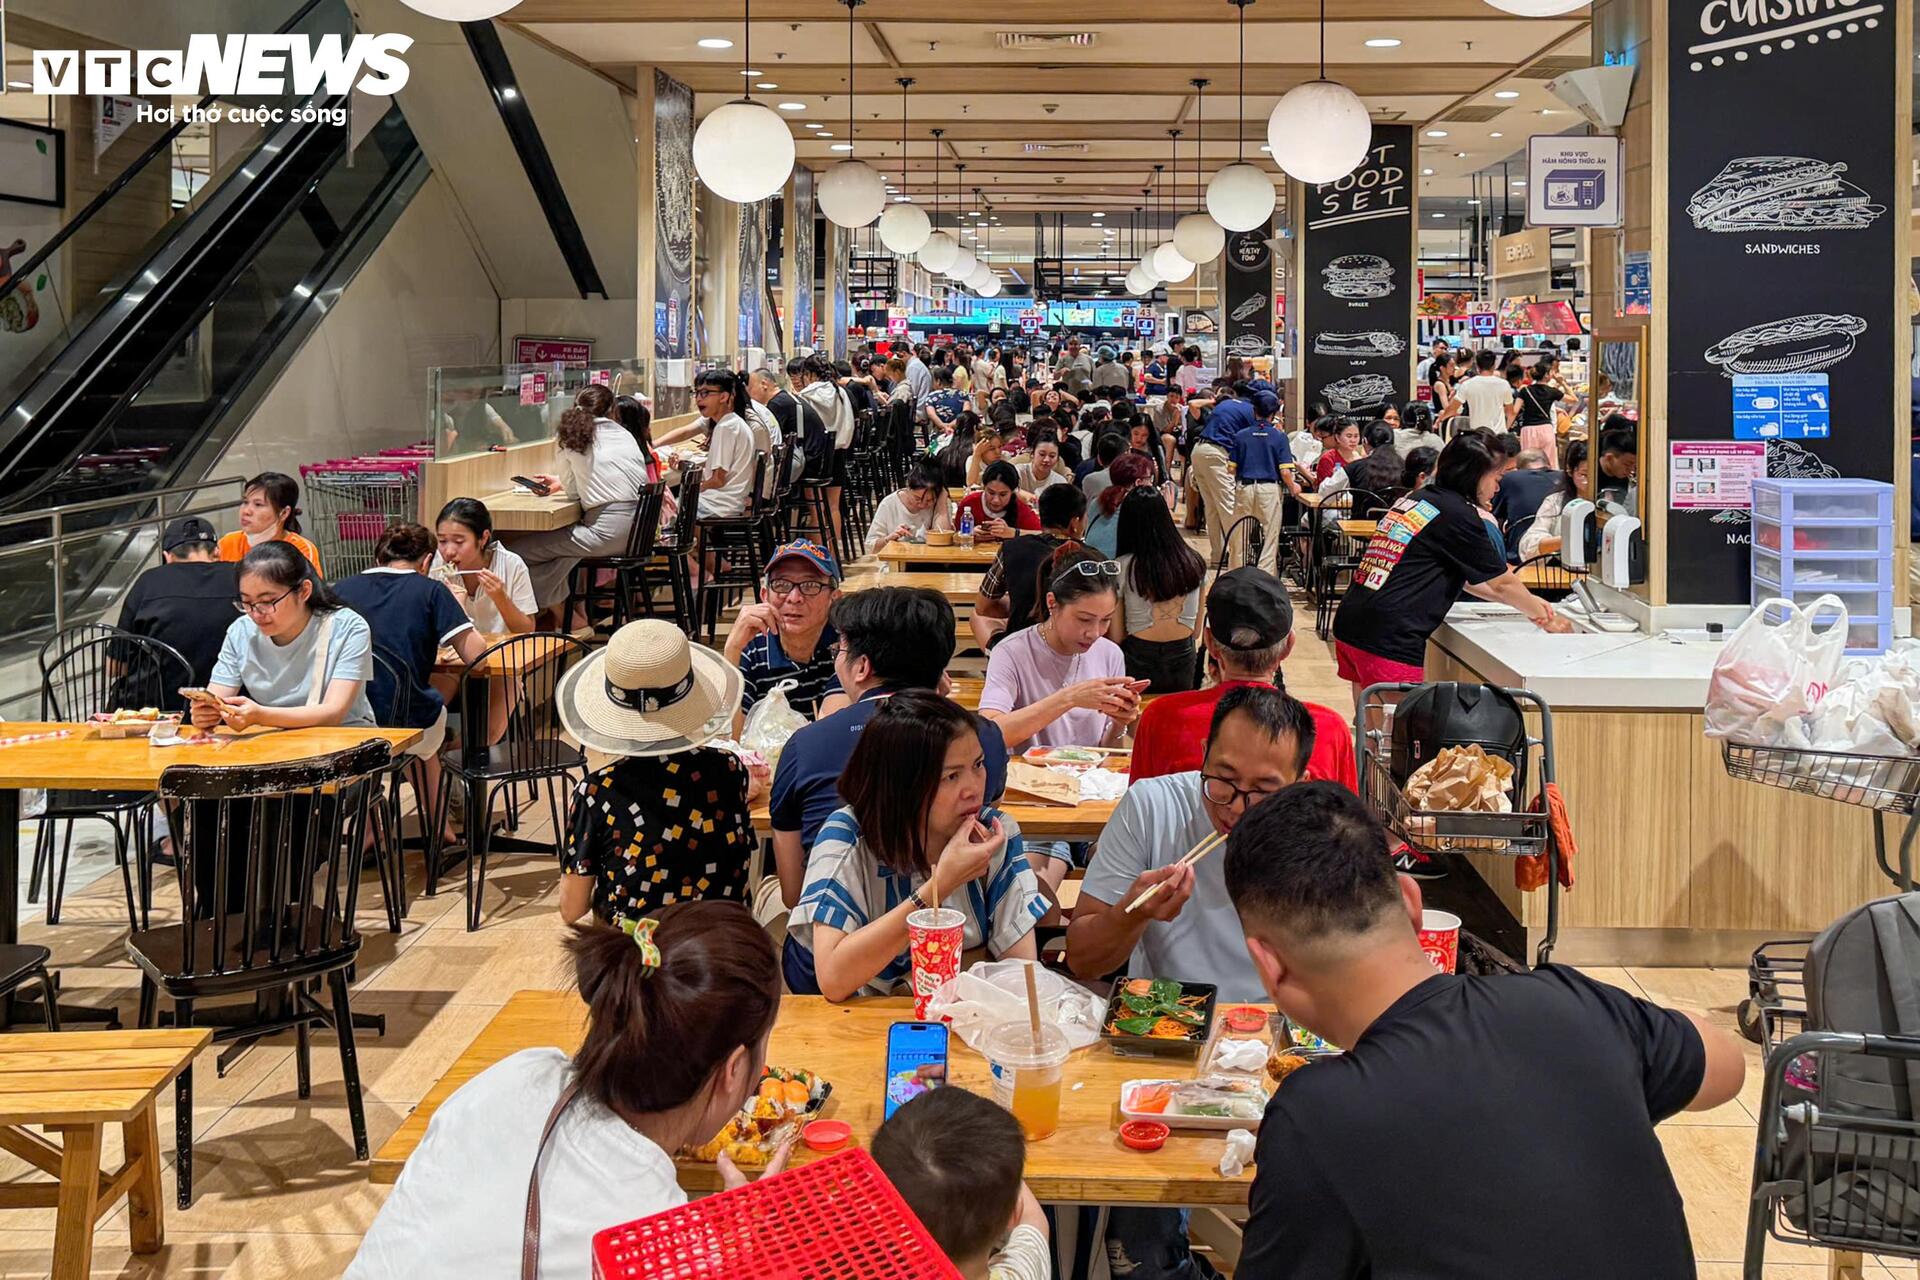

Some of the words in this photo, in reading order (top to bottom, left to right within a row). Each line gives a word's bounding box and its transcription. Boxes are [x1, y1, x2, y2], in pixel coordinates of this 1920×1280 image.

[1322, 186, 1404, 214] SET
[1745, 243, 1821, 255] SANDWICHES
[1476, 302, 1491, 312] 42
[1140, 309, 1151, 317] 43
